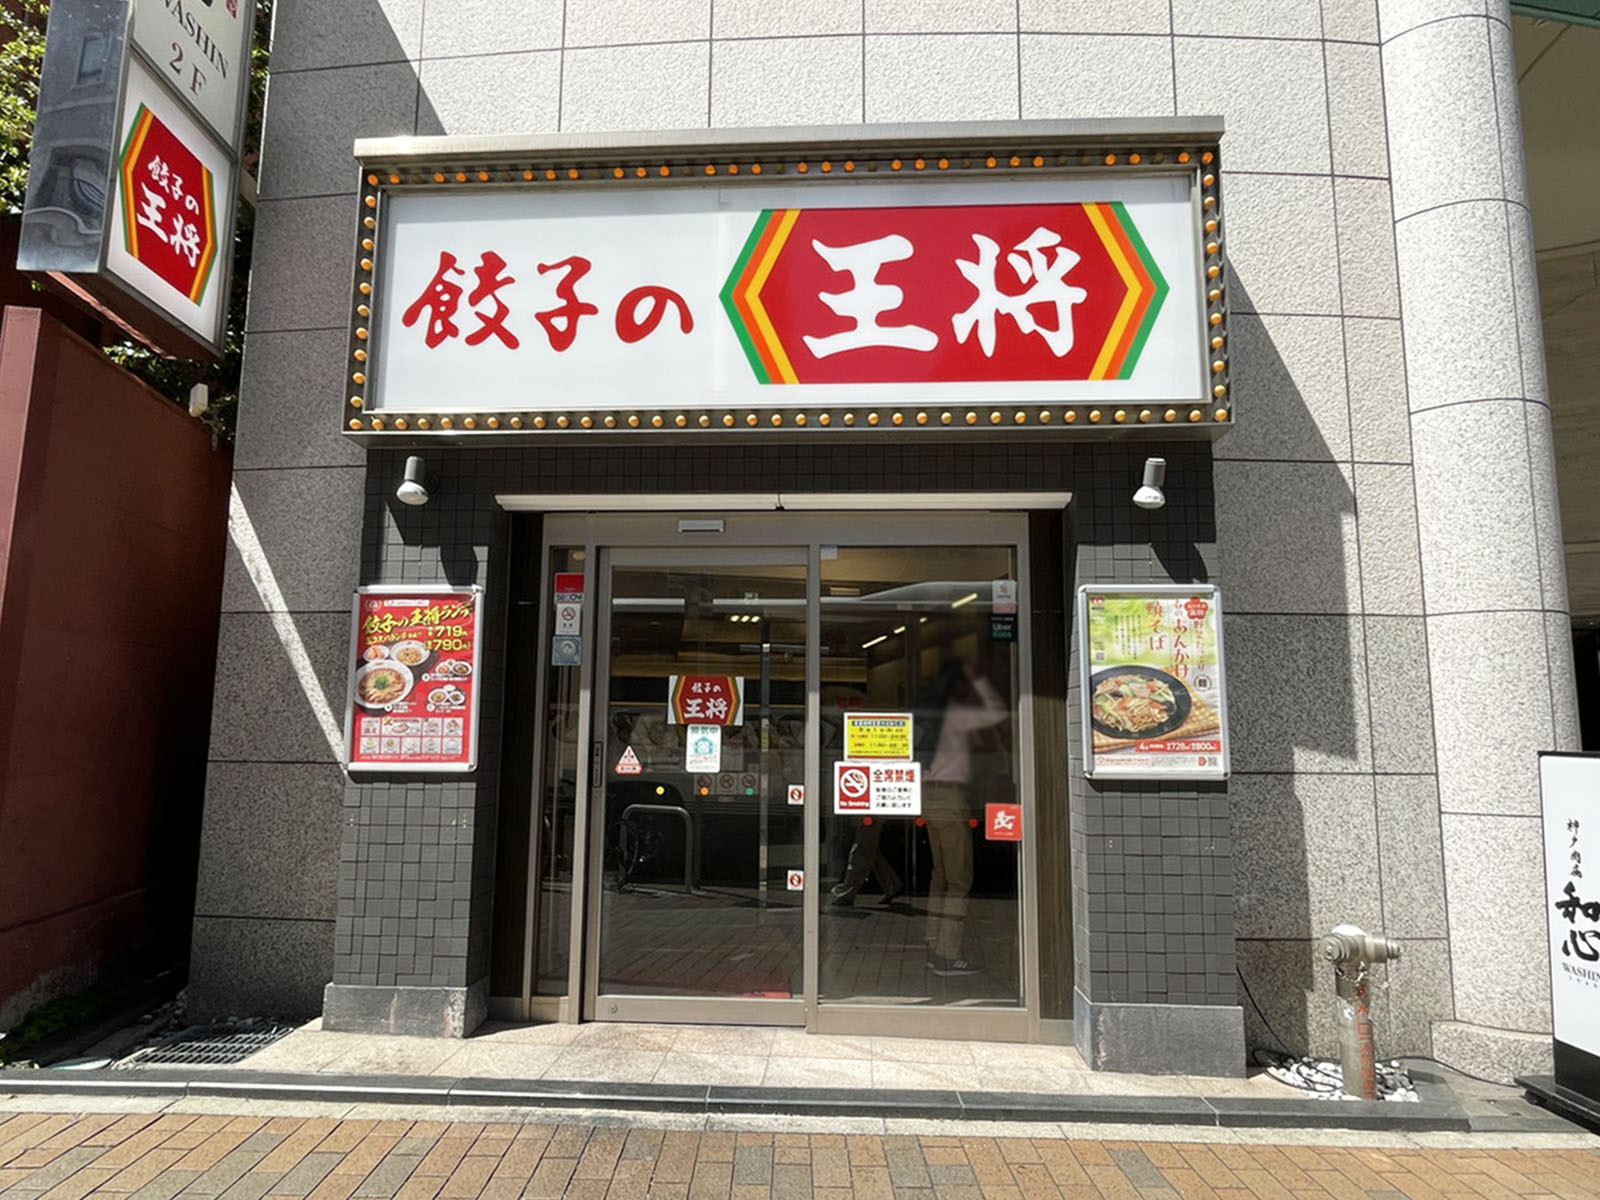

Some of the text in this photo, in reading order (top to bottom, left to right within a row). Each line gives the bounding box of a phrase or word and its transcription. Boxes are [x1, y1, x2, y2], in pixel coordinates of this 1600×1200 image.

[165, 0, 228, 79] ASHIN
[148, 155, 199, 215] 餃子の
[137, 182, 200, 267] 王将
[402, 226, 1087, 358] 餃子の 王将
[684, 697, 728, 719] 王将
[691, 682, 722, 694] 餃子の
[873, 769, 916, 783] 全席禁煙
